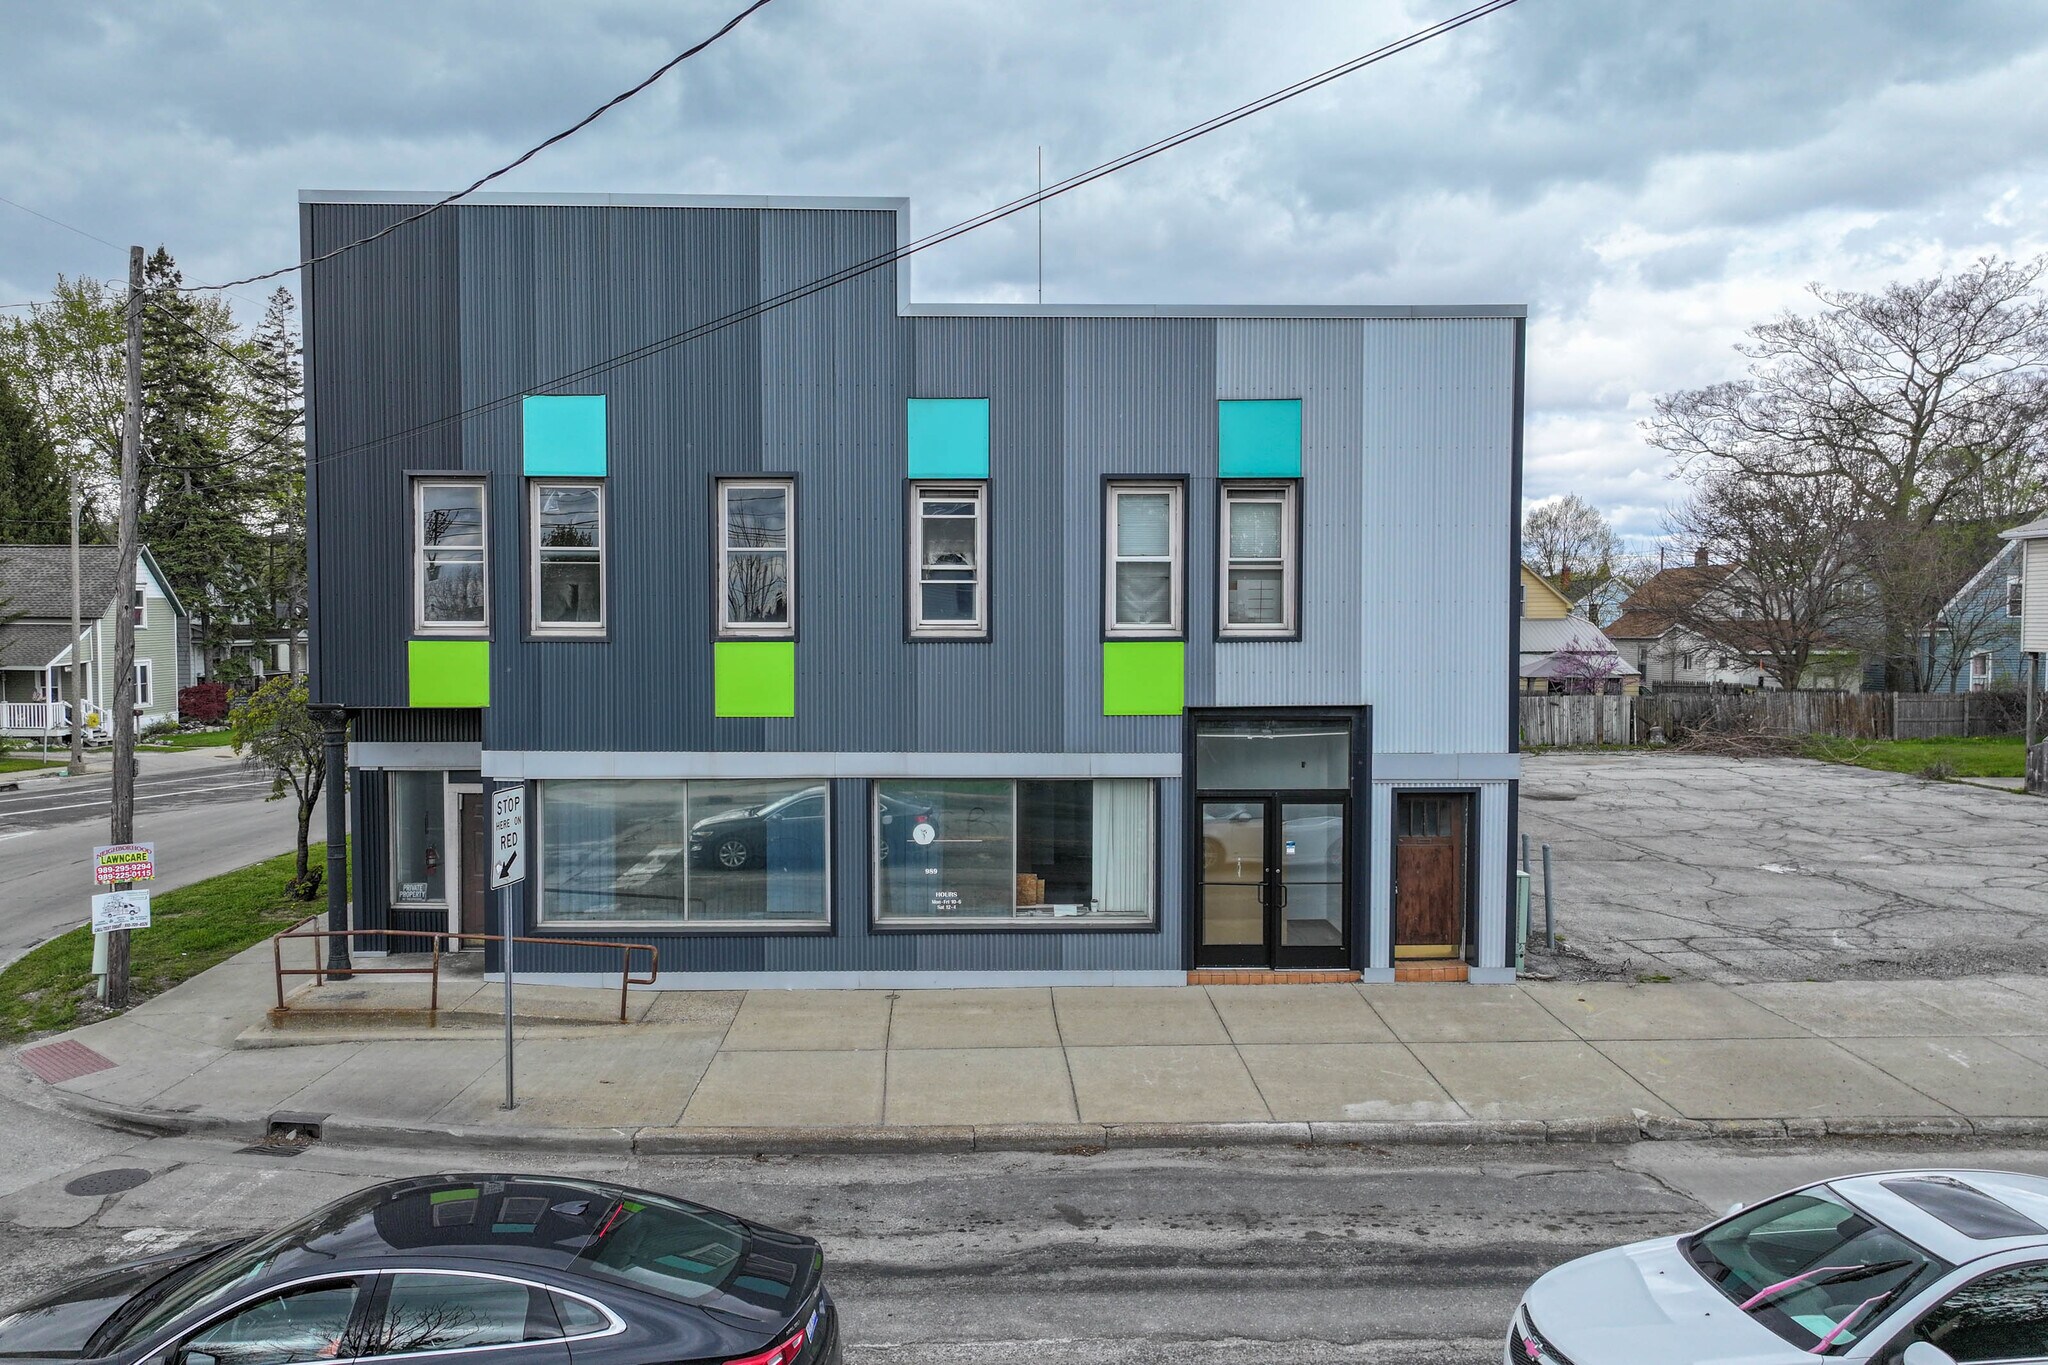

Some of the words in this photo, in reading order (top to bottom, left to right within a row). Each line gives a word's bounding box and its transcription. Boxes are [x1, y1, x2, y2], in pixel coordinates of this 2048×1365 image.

[497, 796, 520, 815] STOP
[496, 818, 510, 831] HERE
[514, 815, 522, 825] ON
[501, 832, 518, 850] RED
[96, 845, 152, 859] NEIGHBORHOOD
[101, 853, 147, 864] LAWNCARE
[98, 863, 151, 873] 989-295-9294
[98, 870, 151, 880] 989-225-0115
